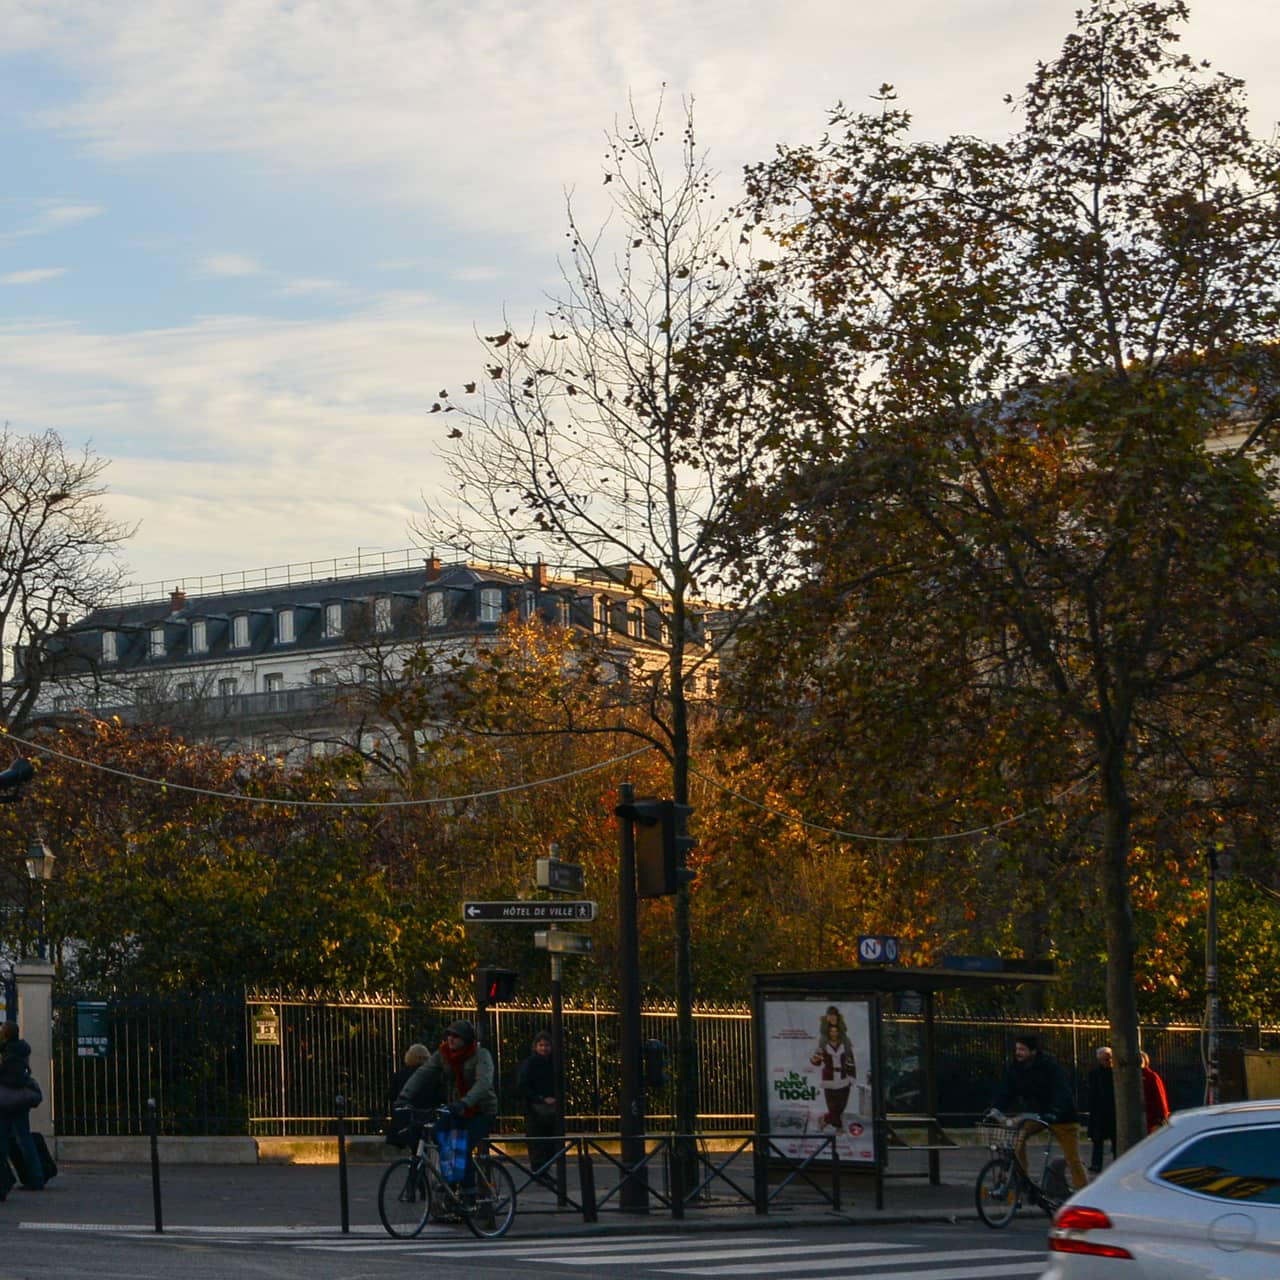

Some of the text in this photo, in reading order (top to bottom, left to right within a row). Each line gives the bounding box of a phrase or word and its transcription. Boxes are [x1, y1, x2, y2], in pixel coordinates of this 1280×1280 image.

[503, 905, 573, 916] HÔTEL DE VILLE
